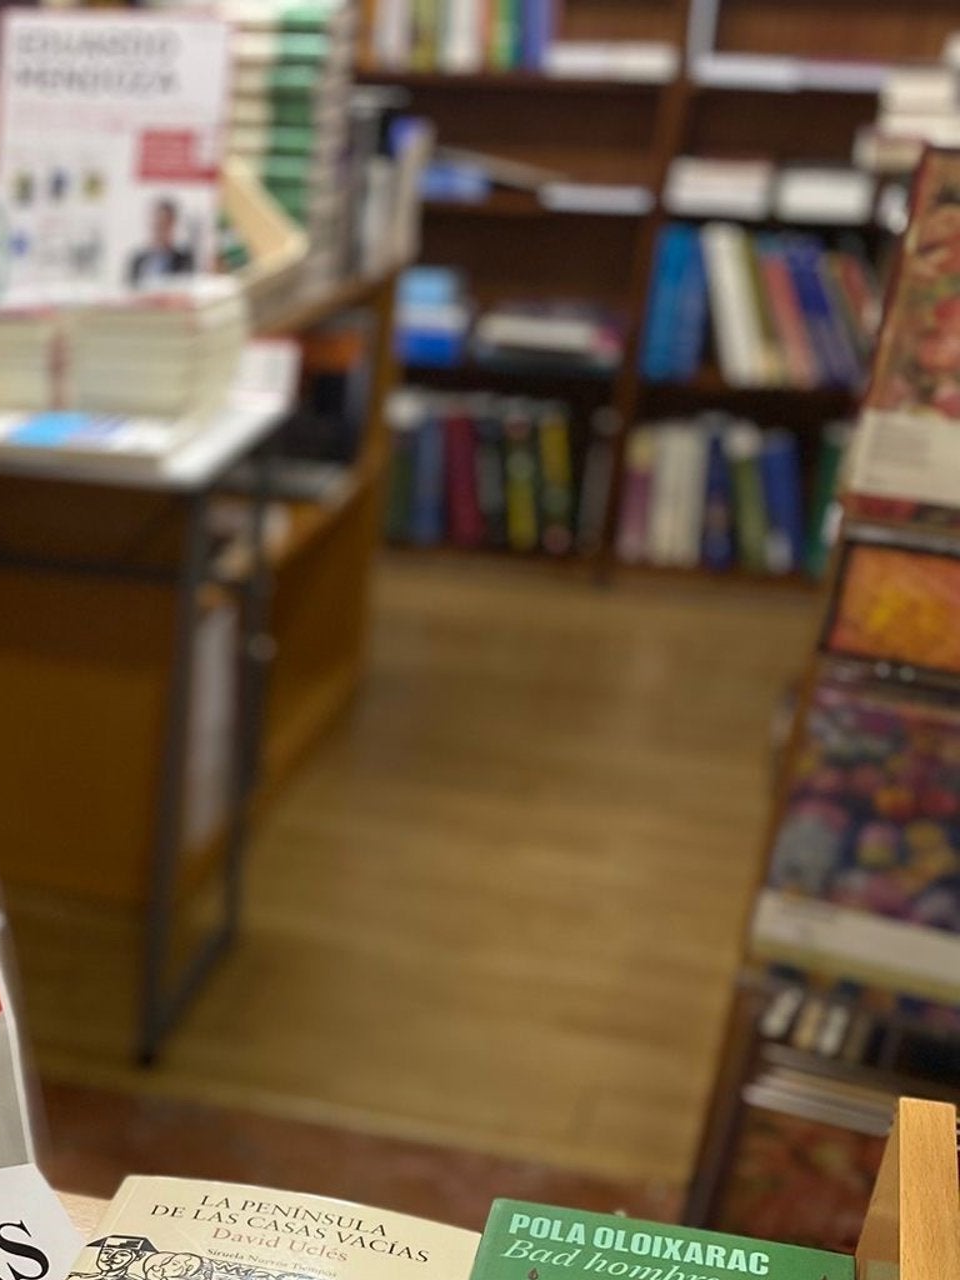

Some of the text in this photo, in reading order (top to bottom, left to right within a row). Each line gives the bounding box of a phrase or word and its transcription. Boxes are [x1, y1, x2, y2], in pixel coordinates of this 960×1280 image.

[150, 1204, 430, 1262] DE LAS CASAS VACÍAS
[200, 1195, 386, 1237] LA PENÍNSULA
[212, 1228, 281, 1248] David
[500, 1239, 583, 1270] Bad
[508, 1213, 770, 1276] POLA OLOIXARAC
